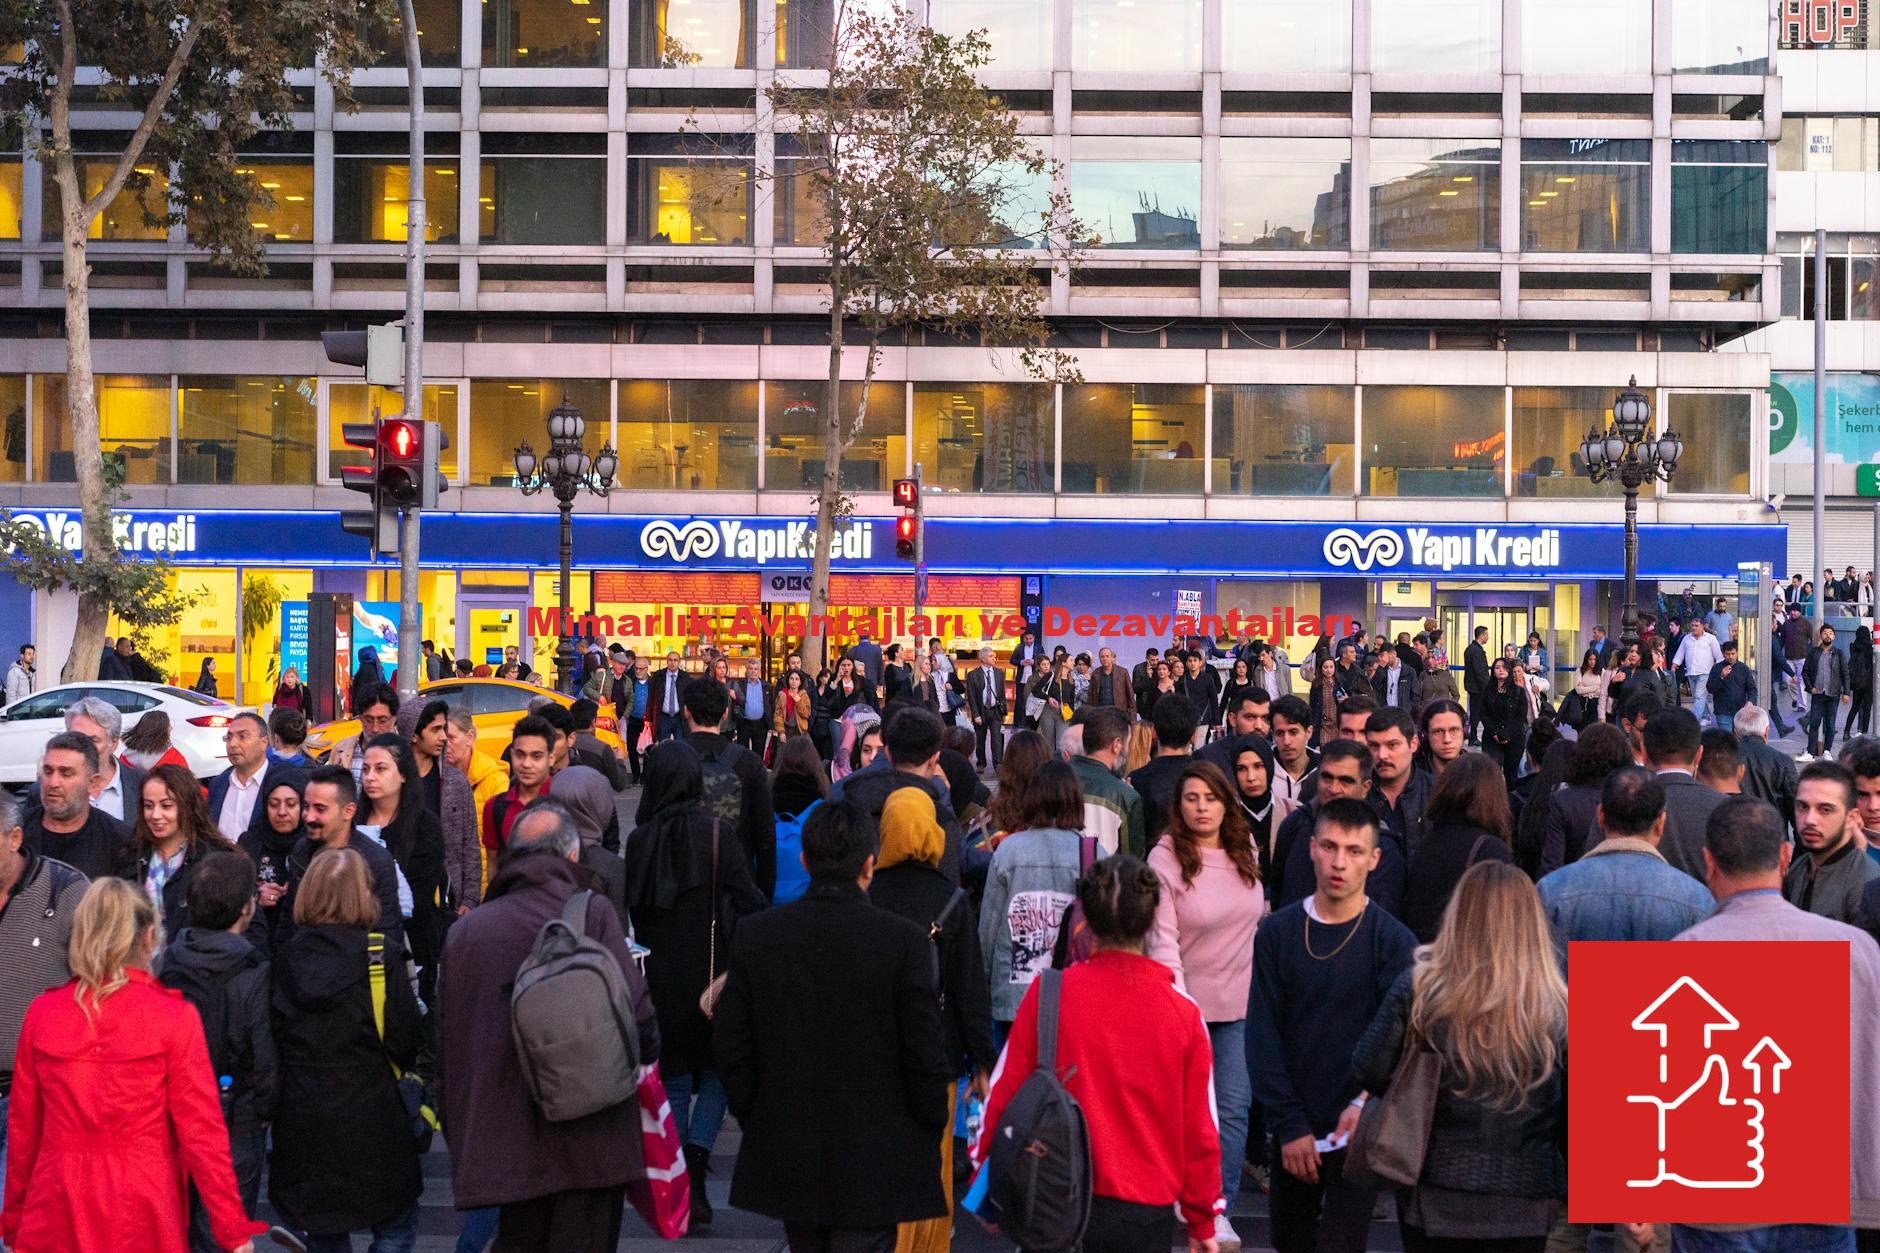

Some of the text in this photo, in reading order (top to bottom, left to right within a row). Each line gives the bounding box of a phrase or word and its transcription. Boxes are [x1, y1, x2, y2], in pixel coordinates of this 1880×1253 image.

[1846, 421, 1874, 433] hem
[900, 484, 911, 501] 4
[1475, 528, 1559, 567] Kredi
[1762, 566, 1770, 576] 2
